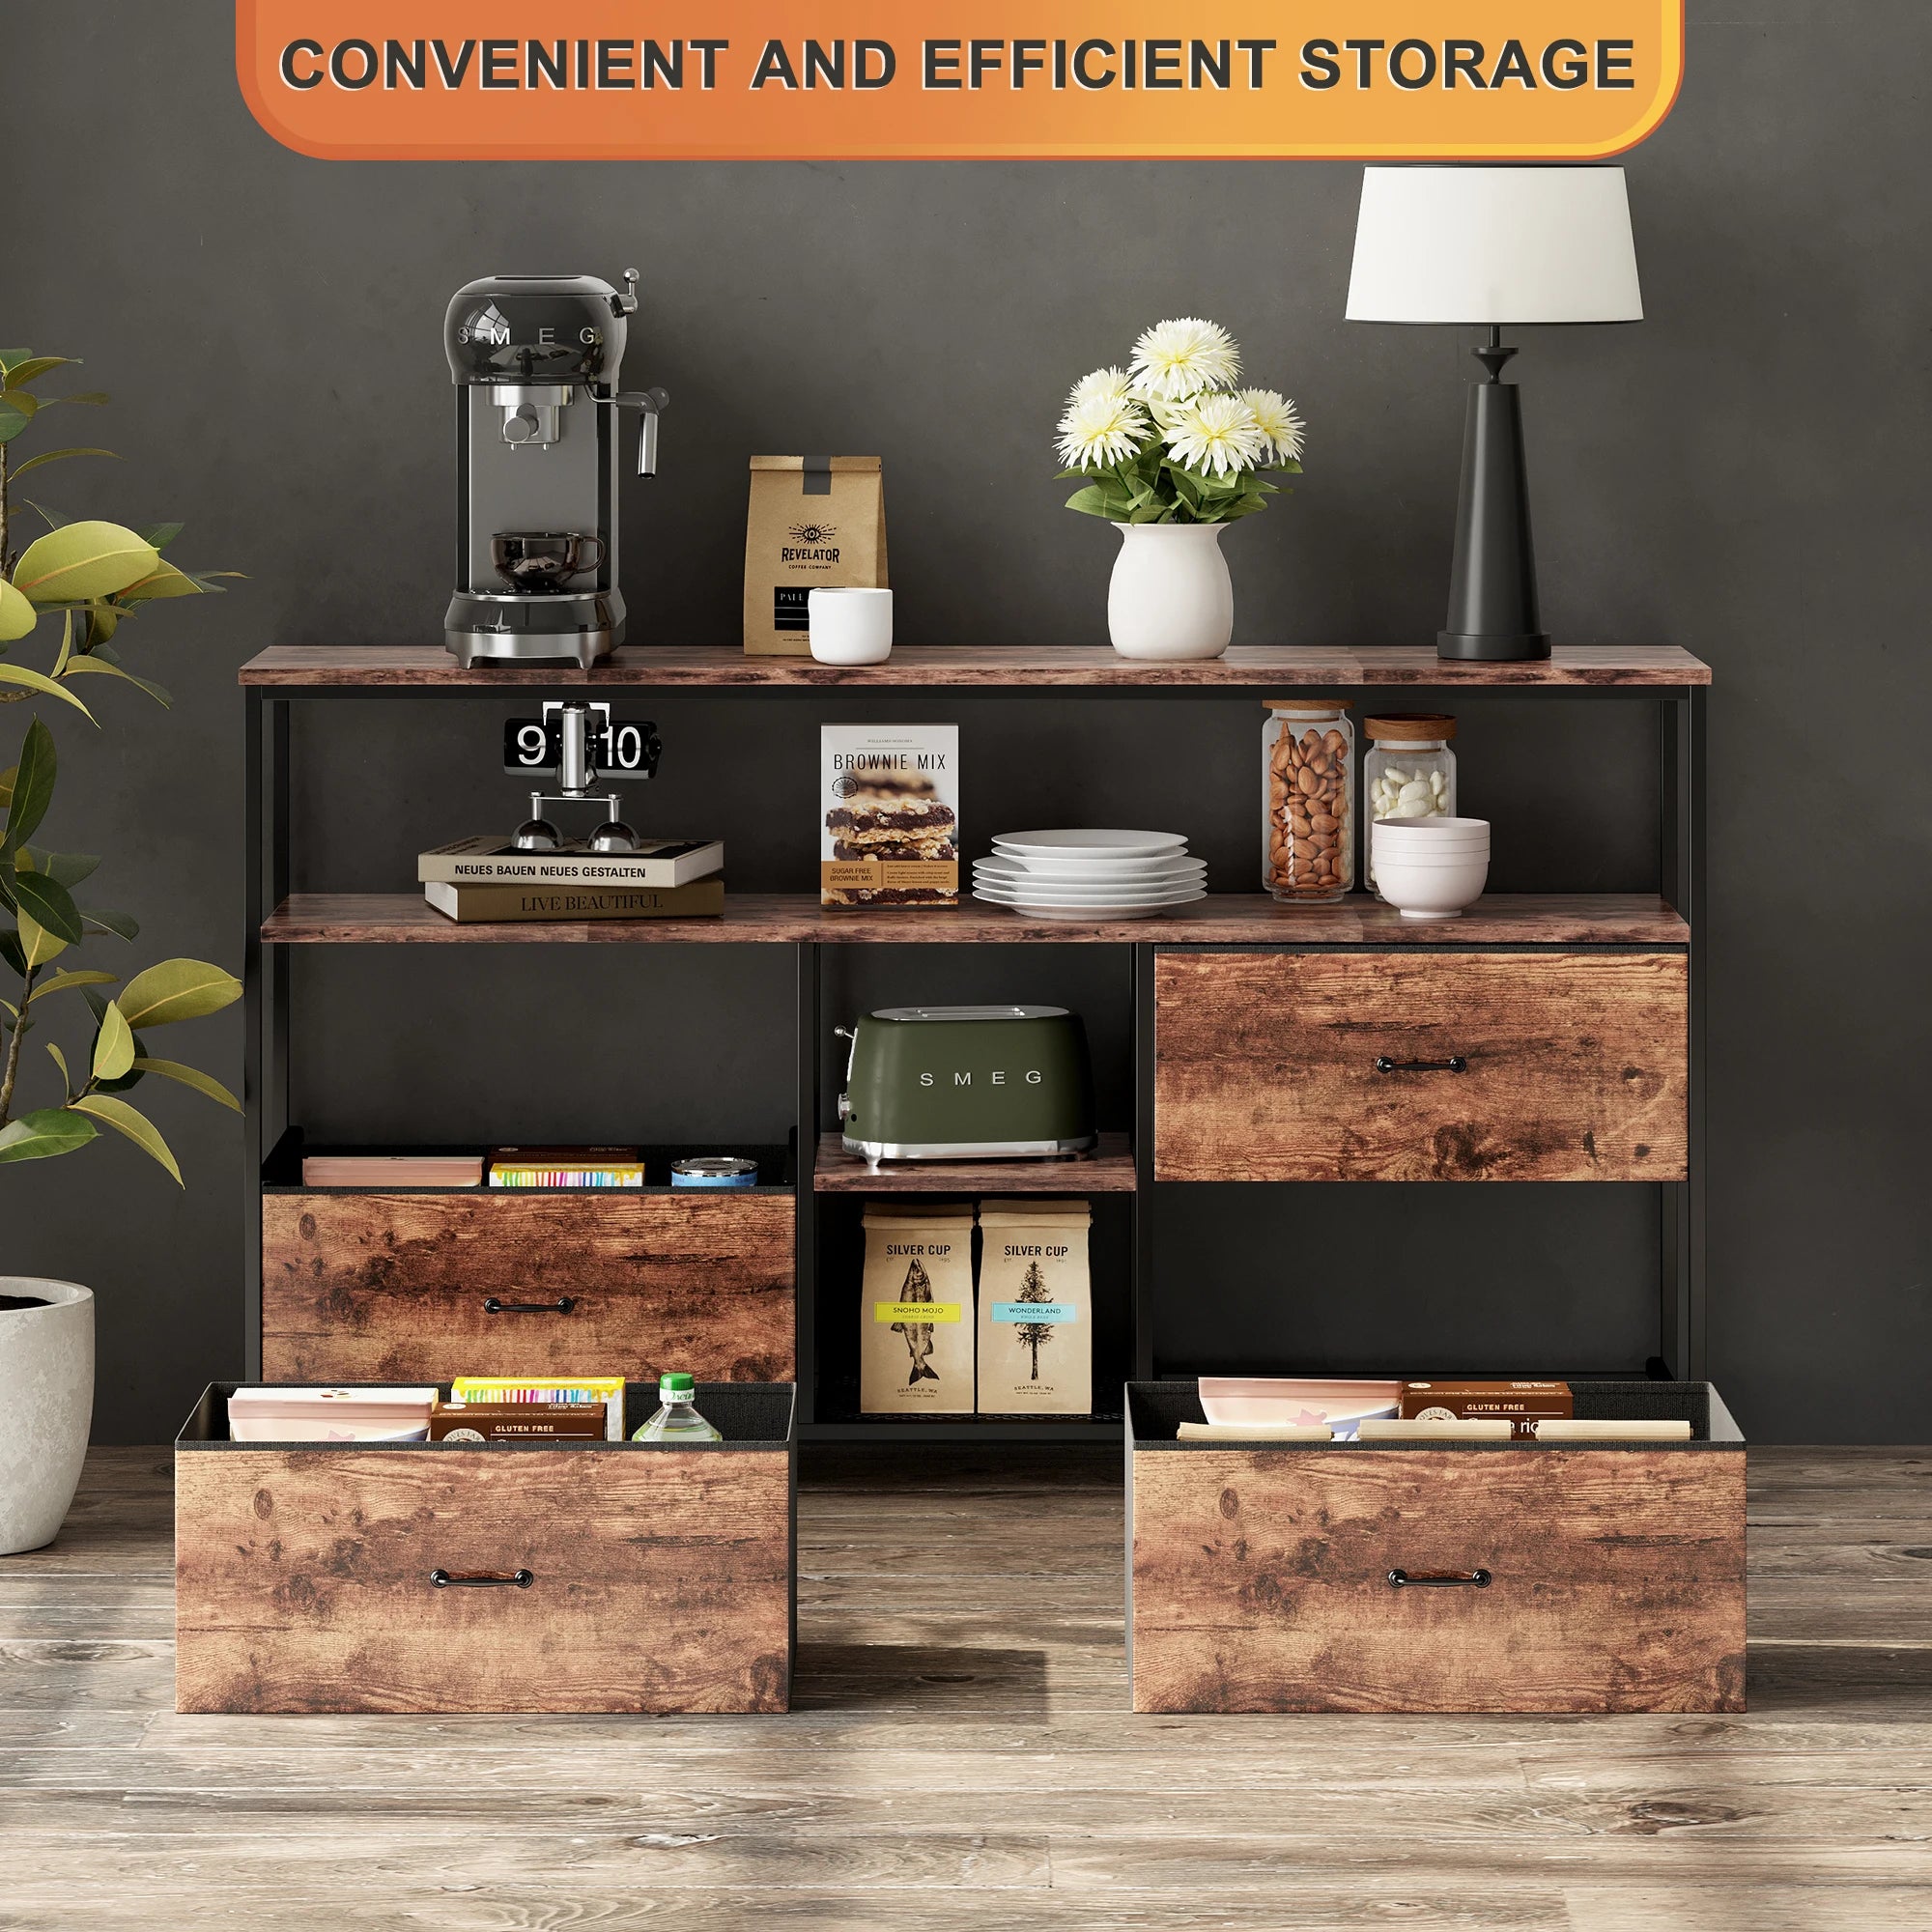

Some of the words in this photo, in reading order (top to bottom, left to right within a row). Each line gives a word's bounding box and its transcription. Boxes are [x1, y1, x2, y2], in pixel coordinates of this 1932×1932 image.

[458, 327, 595, 345] SMEG
[781, 548, 840, 563] REVELATOR
[517, 725, 547, 765] 9
[600, 725, 641, 769] 10
[834, 753, 908, 770] BROWNIE
[917, 753, 946, 770] MIX
[454, 865, 494, 875] NEUES
[497, 865, 536, 876] BAUEN
[540, 866, 579, 877] NEUES
[582, 867, 646, 878] GESTALTEN
[521, 896, 561, 912] LIVE
[565, 894, 664, 911] BEAUTIFUL
[920, 1070, 1042, 1087] SMEG
[886, 1244, 924, 1256] SILVER
[928, 1244, 952, 1256] CUP
[1004, 1245, 1042, 1257] SILVER
[1045, 1245, 1068, 1257] CUP
[1520, 1417, 1539, 1434] ric
